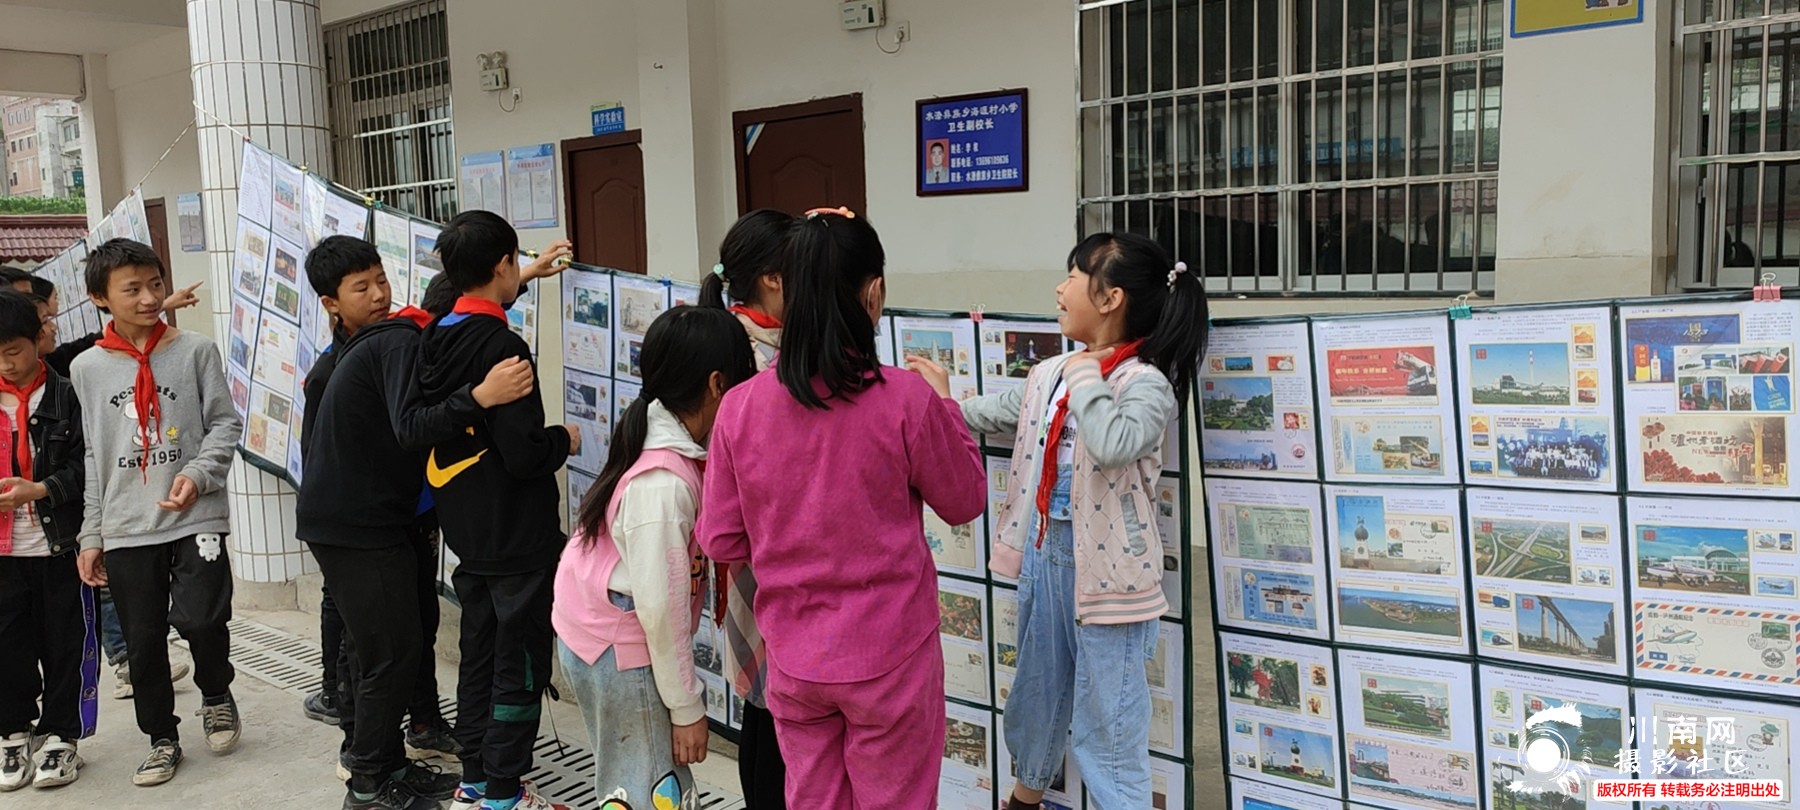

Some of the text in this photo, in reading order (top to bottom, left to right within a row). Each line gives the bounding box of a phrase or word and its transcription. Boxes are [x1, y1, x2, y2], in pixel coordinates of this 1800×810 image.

[947, 118, 994, 133] 卫生副校长
[109, 384, 178, 409] Peauts
[152, 448, 183, 466] 1950
